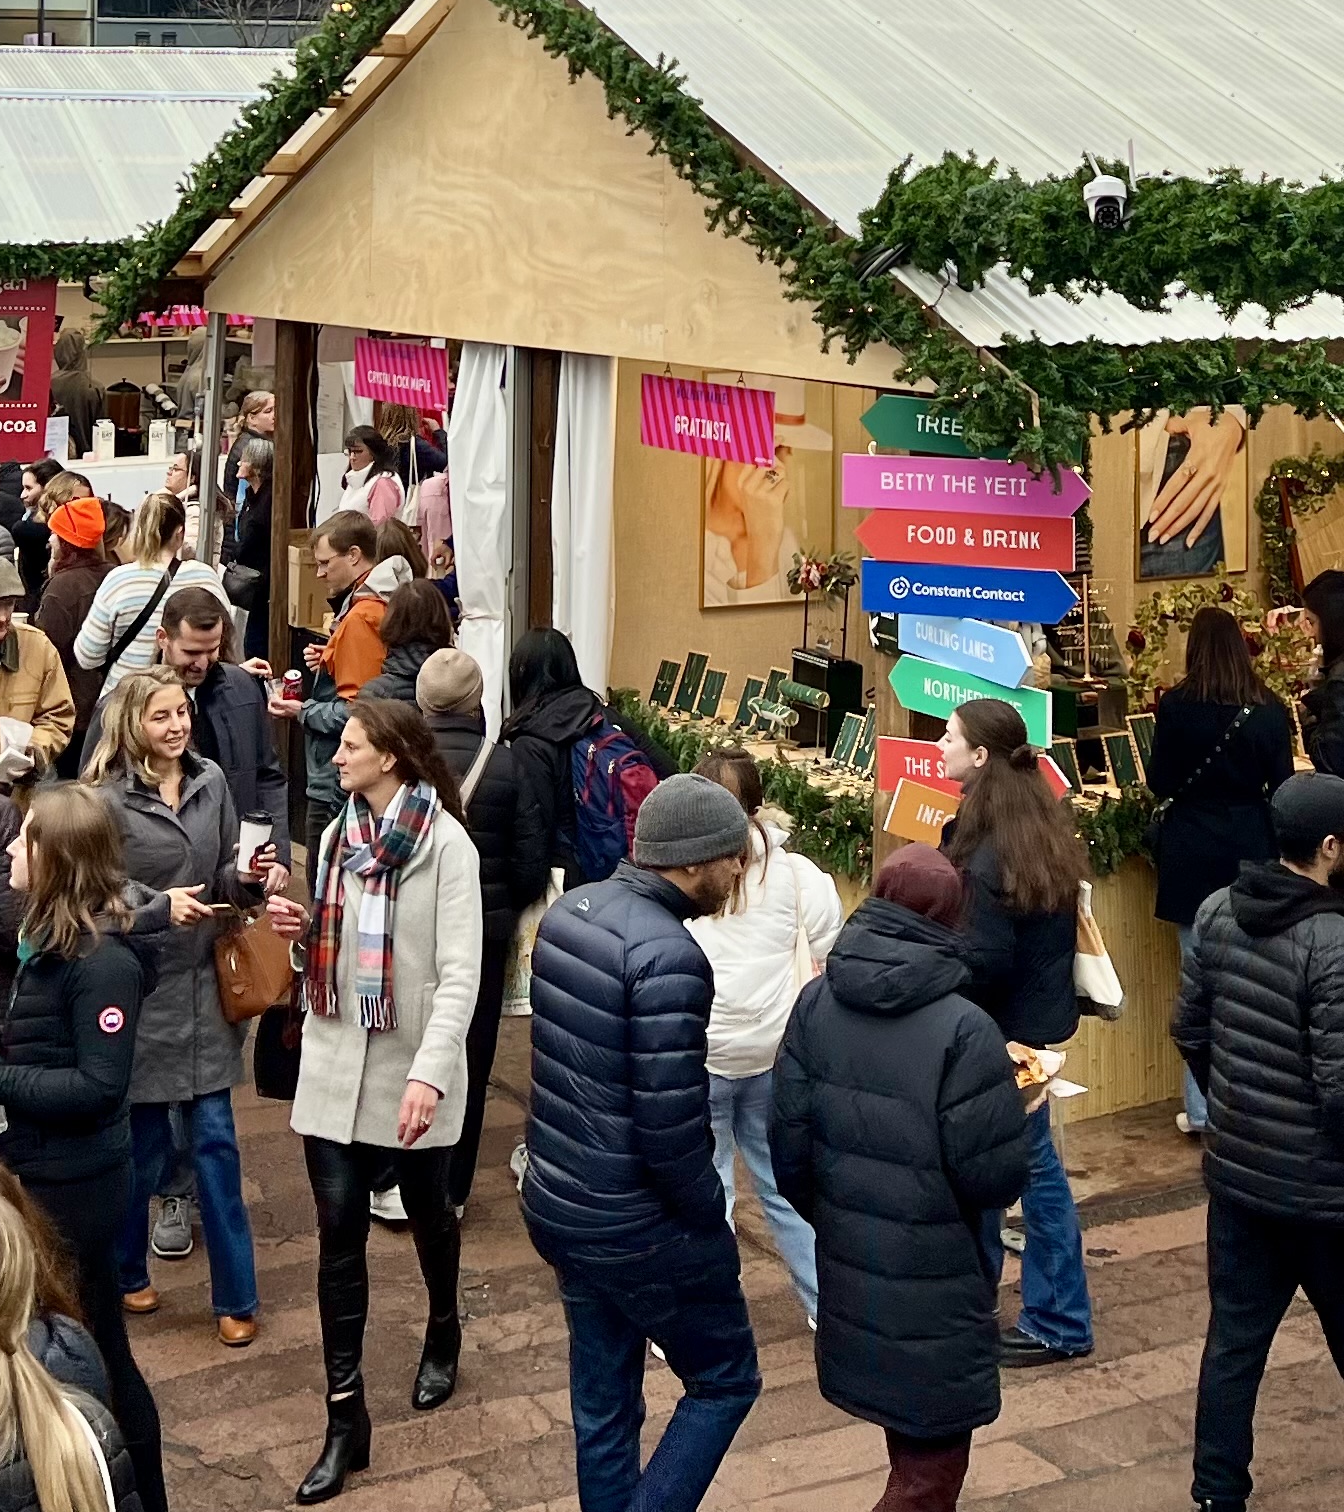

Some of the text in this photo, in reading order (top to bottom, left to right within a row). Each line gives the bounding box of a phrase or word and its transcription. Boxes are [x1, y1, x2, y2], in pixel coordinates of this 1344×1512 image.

[674, 414, 732, 443] GRATINSTA
[880, 472, 1027, 497] BETTY THE YETI
[907, 525, 1041, 550] FOOD & DRINK
[912, 582, 1025, 602] Constant Contact
[916, 622, 995, 663] CURLING LANES
[904, 756, 932, 778] THE
